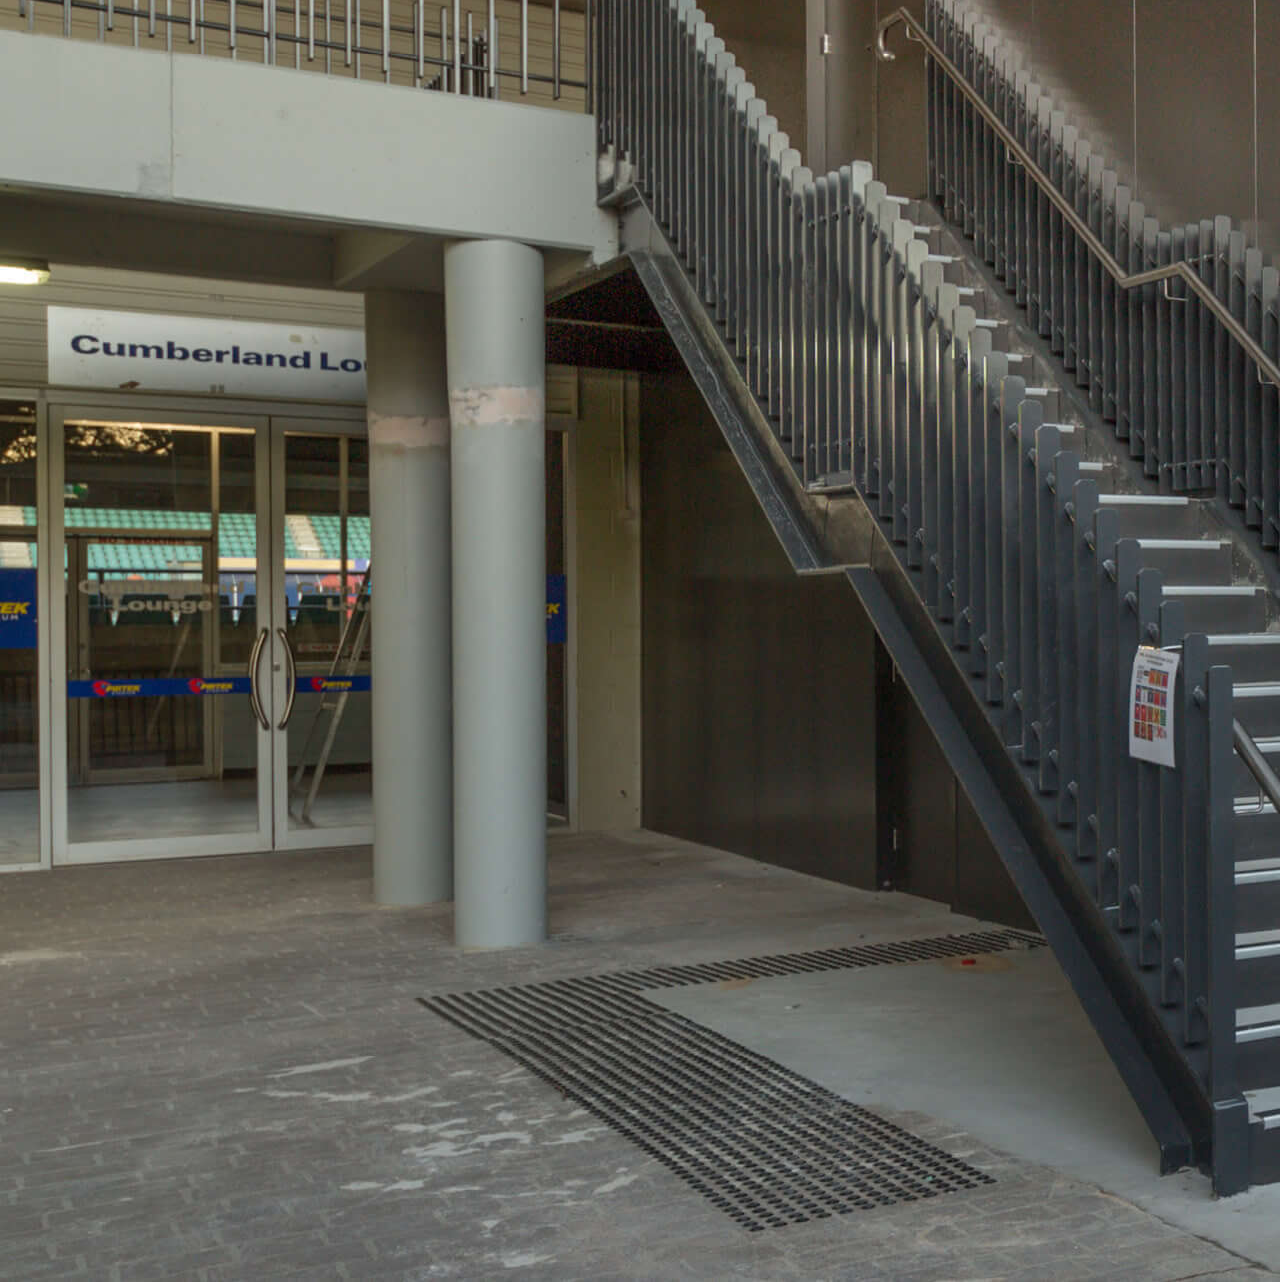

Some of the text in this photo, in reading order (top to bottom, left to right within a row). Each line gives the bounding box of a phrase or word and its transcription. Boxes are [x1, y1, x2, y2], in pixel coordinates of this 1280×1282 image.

[70, 334, 367, 373] Cumberland Lo
[113, 597, 212, 613] Lounge
